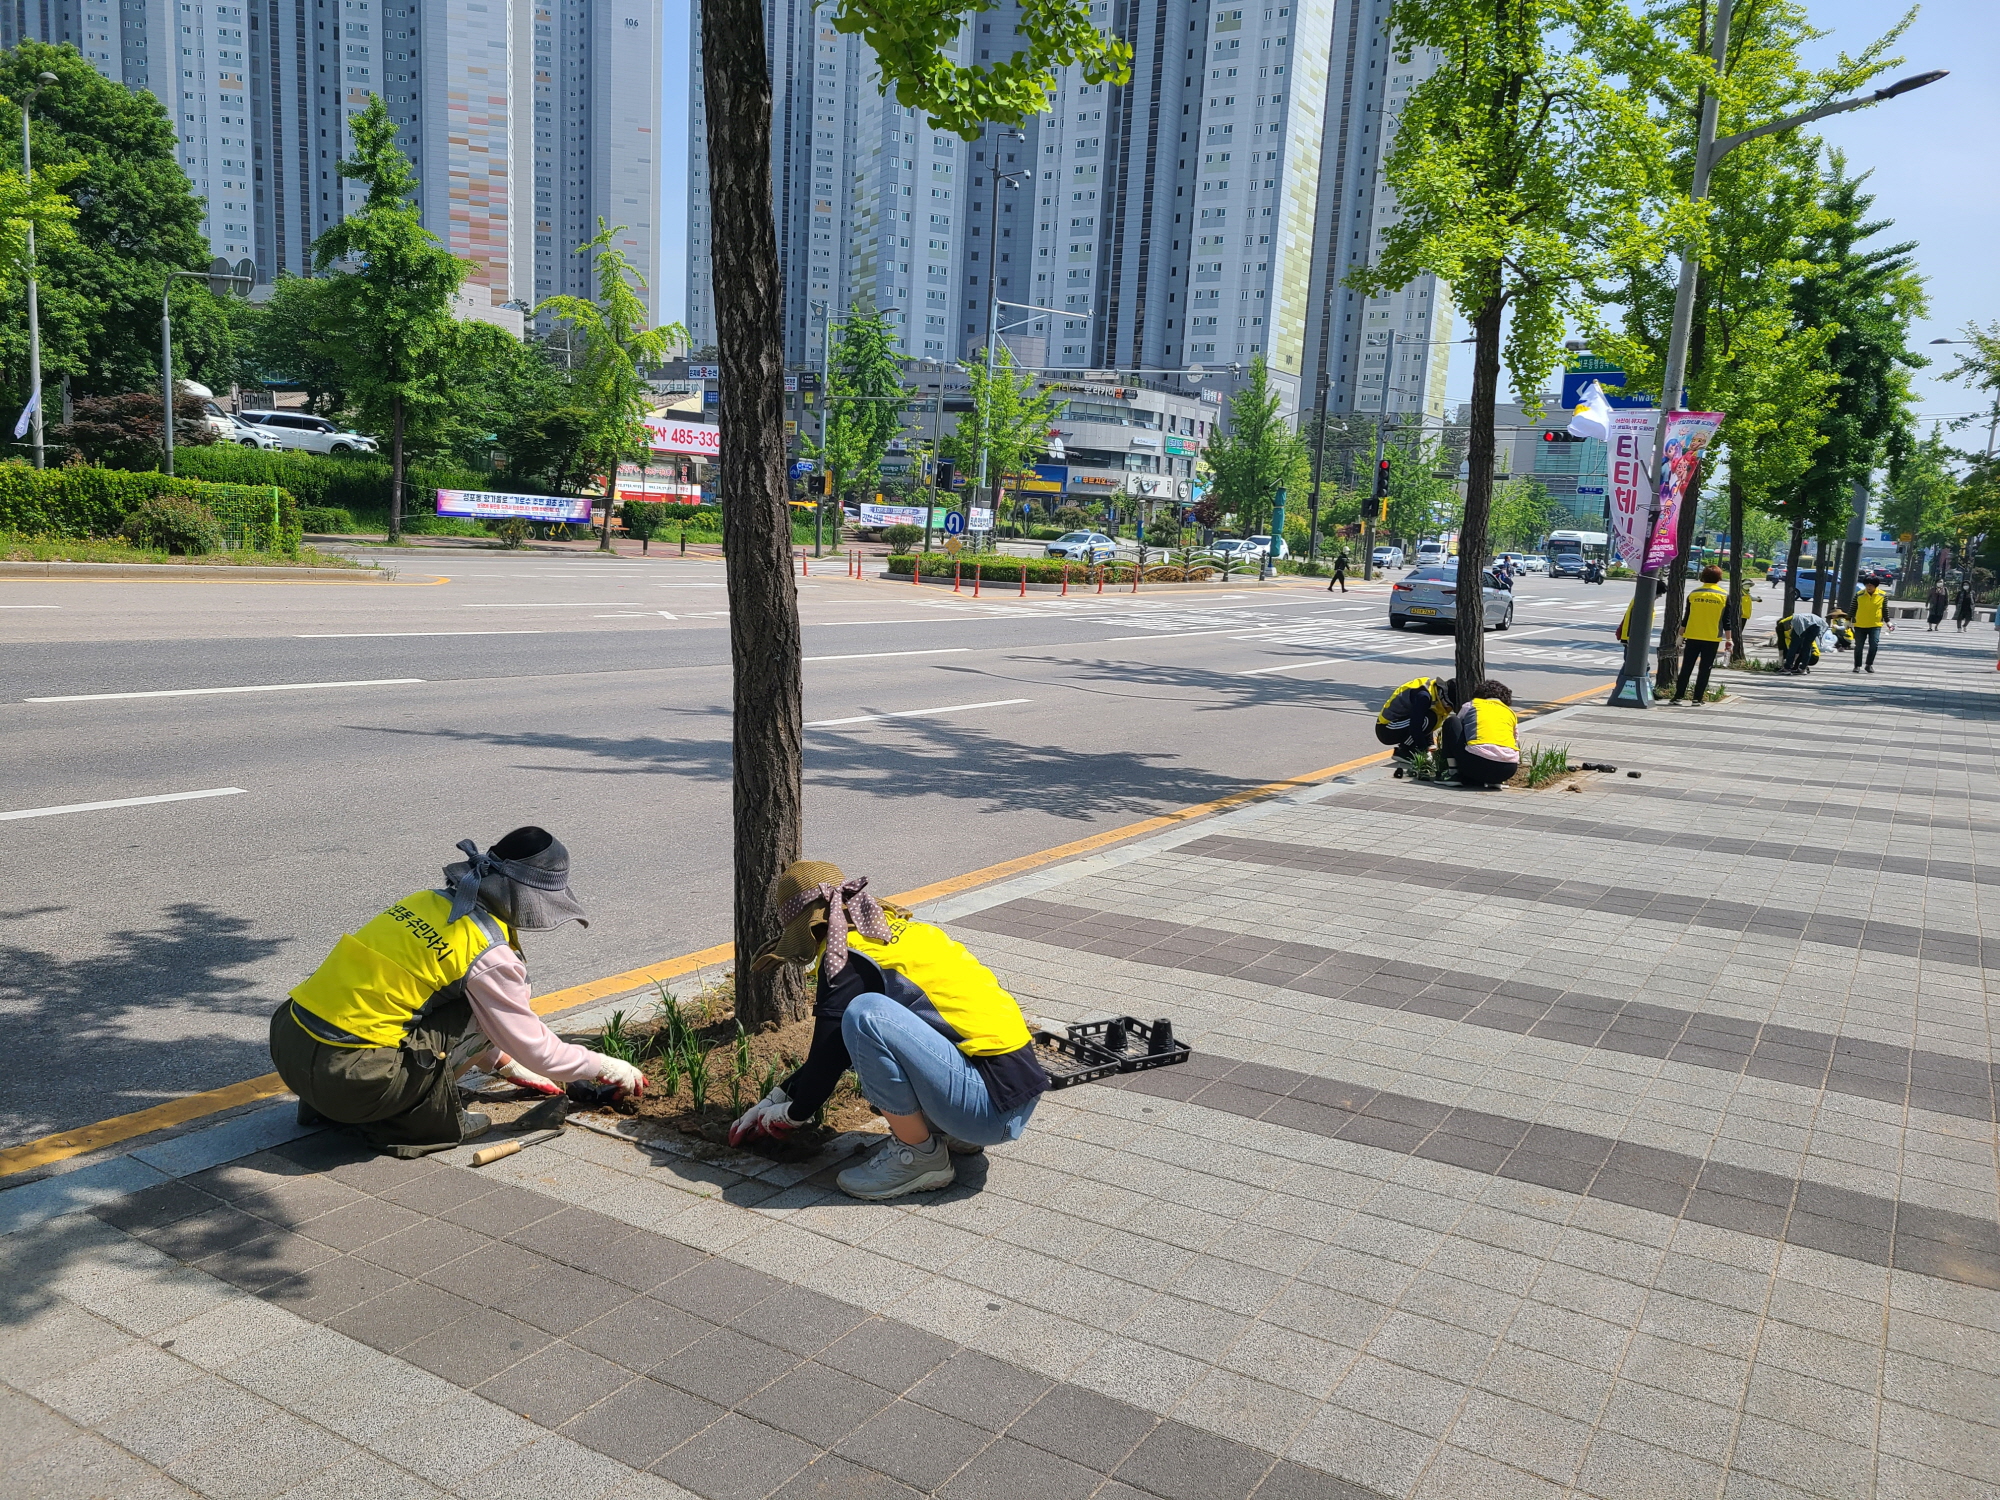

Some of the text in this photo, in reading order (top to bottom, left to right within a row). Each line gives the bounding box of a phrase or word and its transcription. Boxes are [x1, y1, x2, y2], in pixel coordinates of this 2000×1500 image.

[625, 17, 639, 27] 106
[671, 428, 720, 447] 485-330
[405, 917, 454, 962] 주민자치
